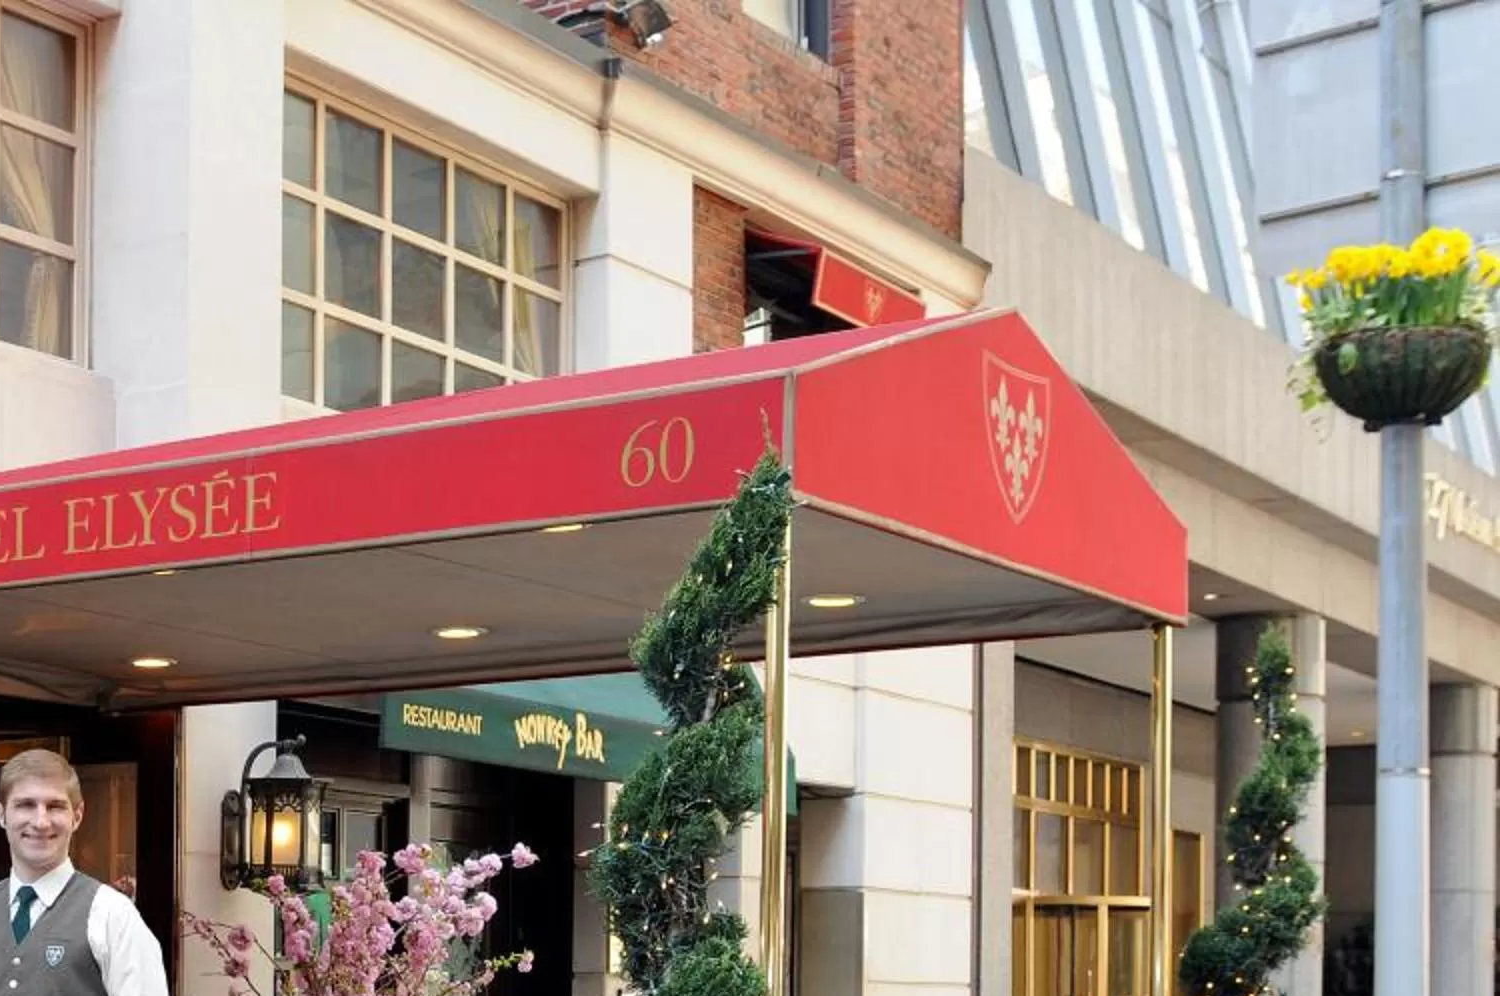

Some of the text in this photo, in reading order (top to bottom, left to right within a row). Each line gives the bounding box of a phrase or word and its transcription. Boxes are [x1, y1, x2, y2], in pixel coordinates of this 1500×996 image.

[621, 416, 694, 487] 60
[61, 469, 280, 556] ELYSÉE
[402, 703, 483, 736] RESTAURANT
